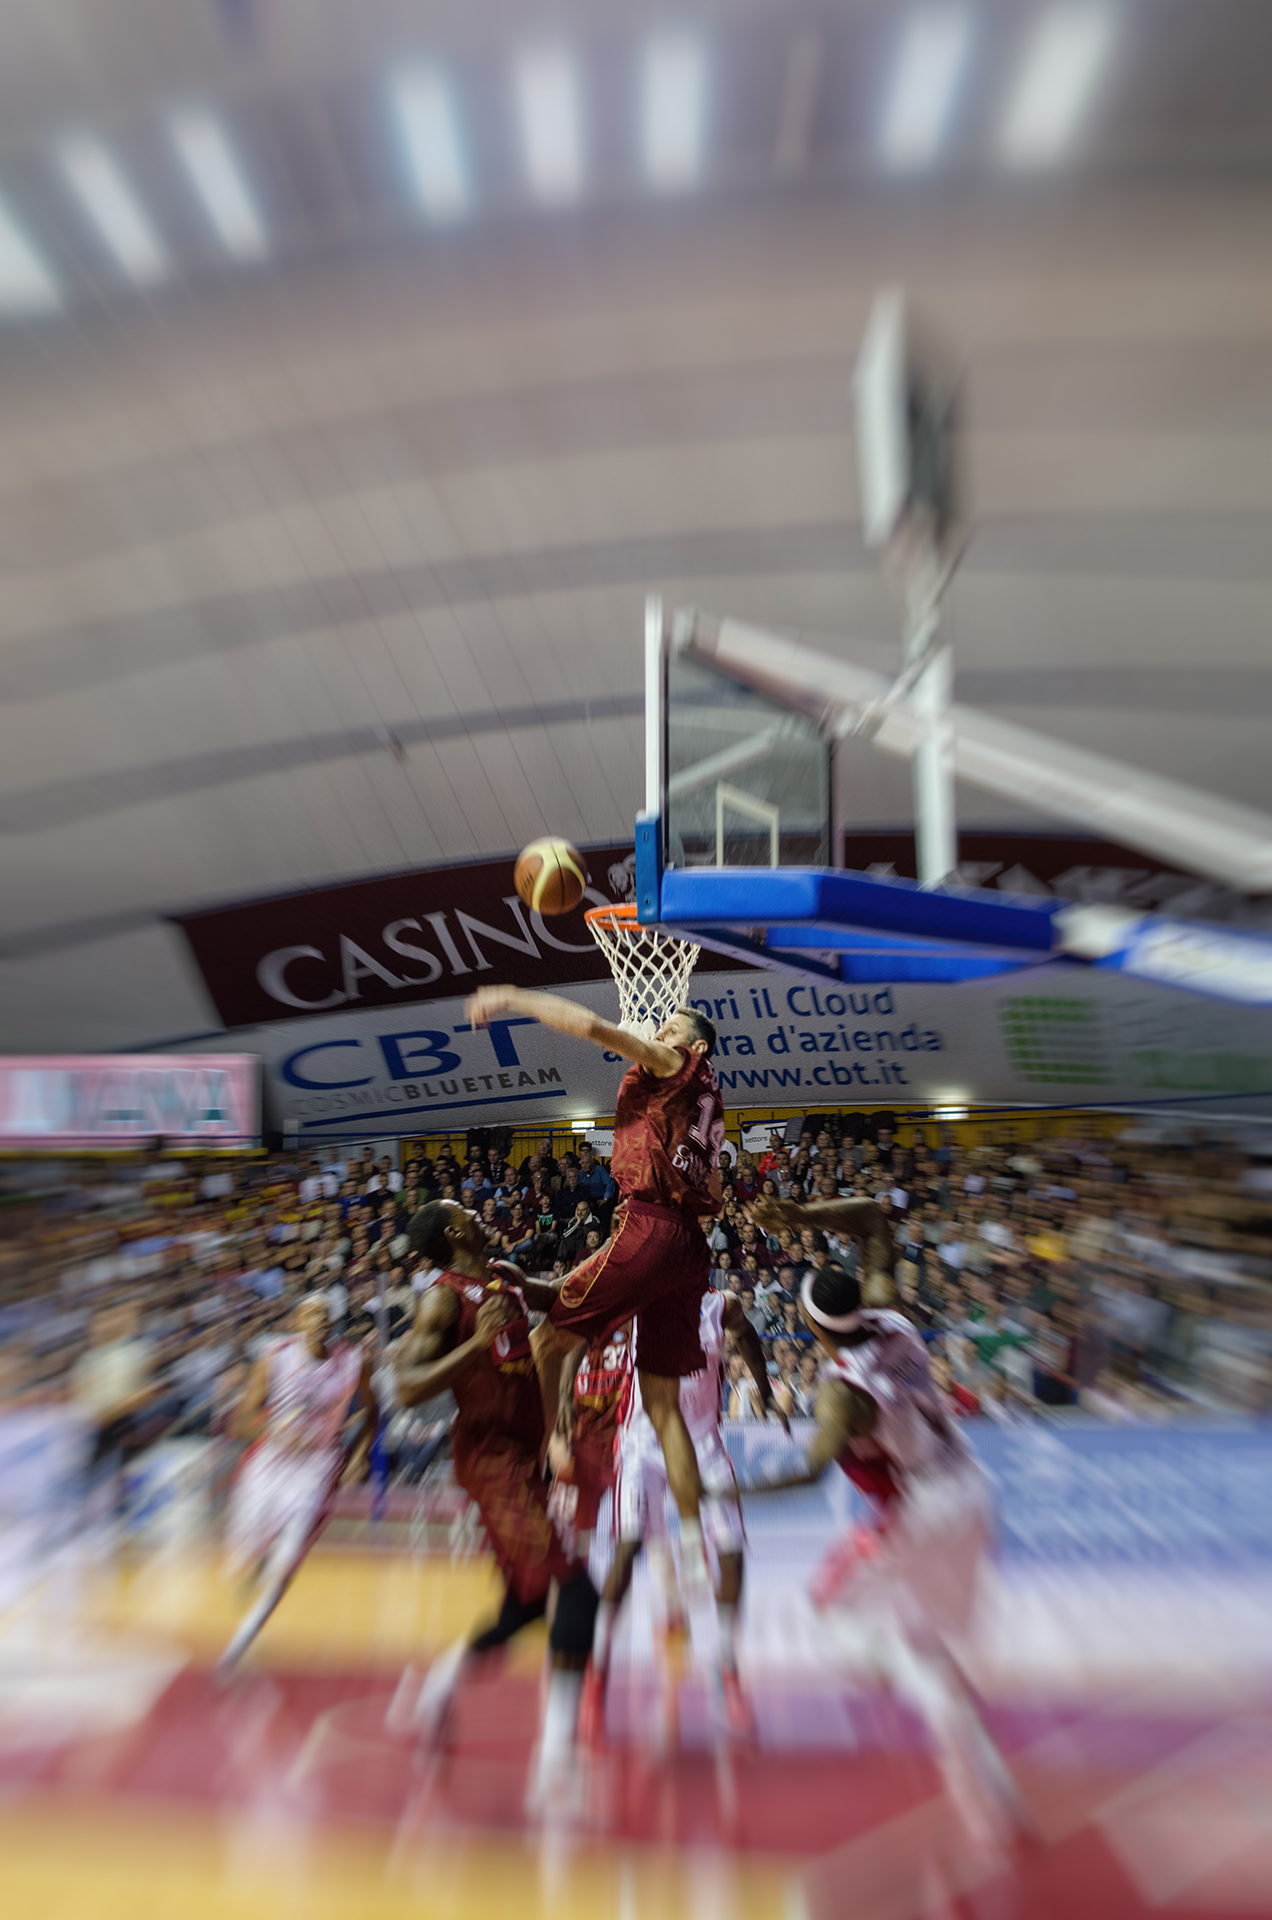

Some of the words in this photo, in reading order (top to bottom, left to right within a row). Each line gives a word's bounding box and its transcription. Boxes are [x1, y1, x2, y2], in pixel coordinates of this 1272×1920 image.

[750, 988, 778, 1019] il
[786, 985, 895, 1017] Cloud
[282, 1017, 541, 1090] CBT
[767, 1023, 944, 1055] d'azienda
[718, 1059, 911, 1090] www.cbt.it
